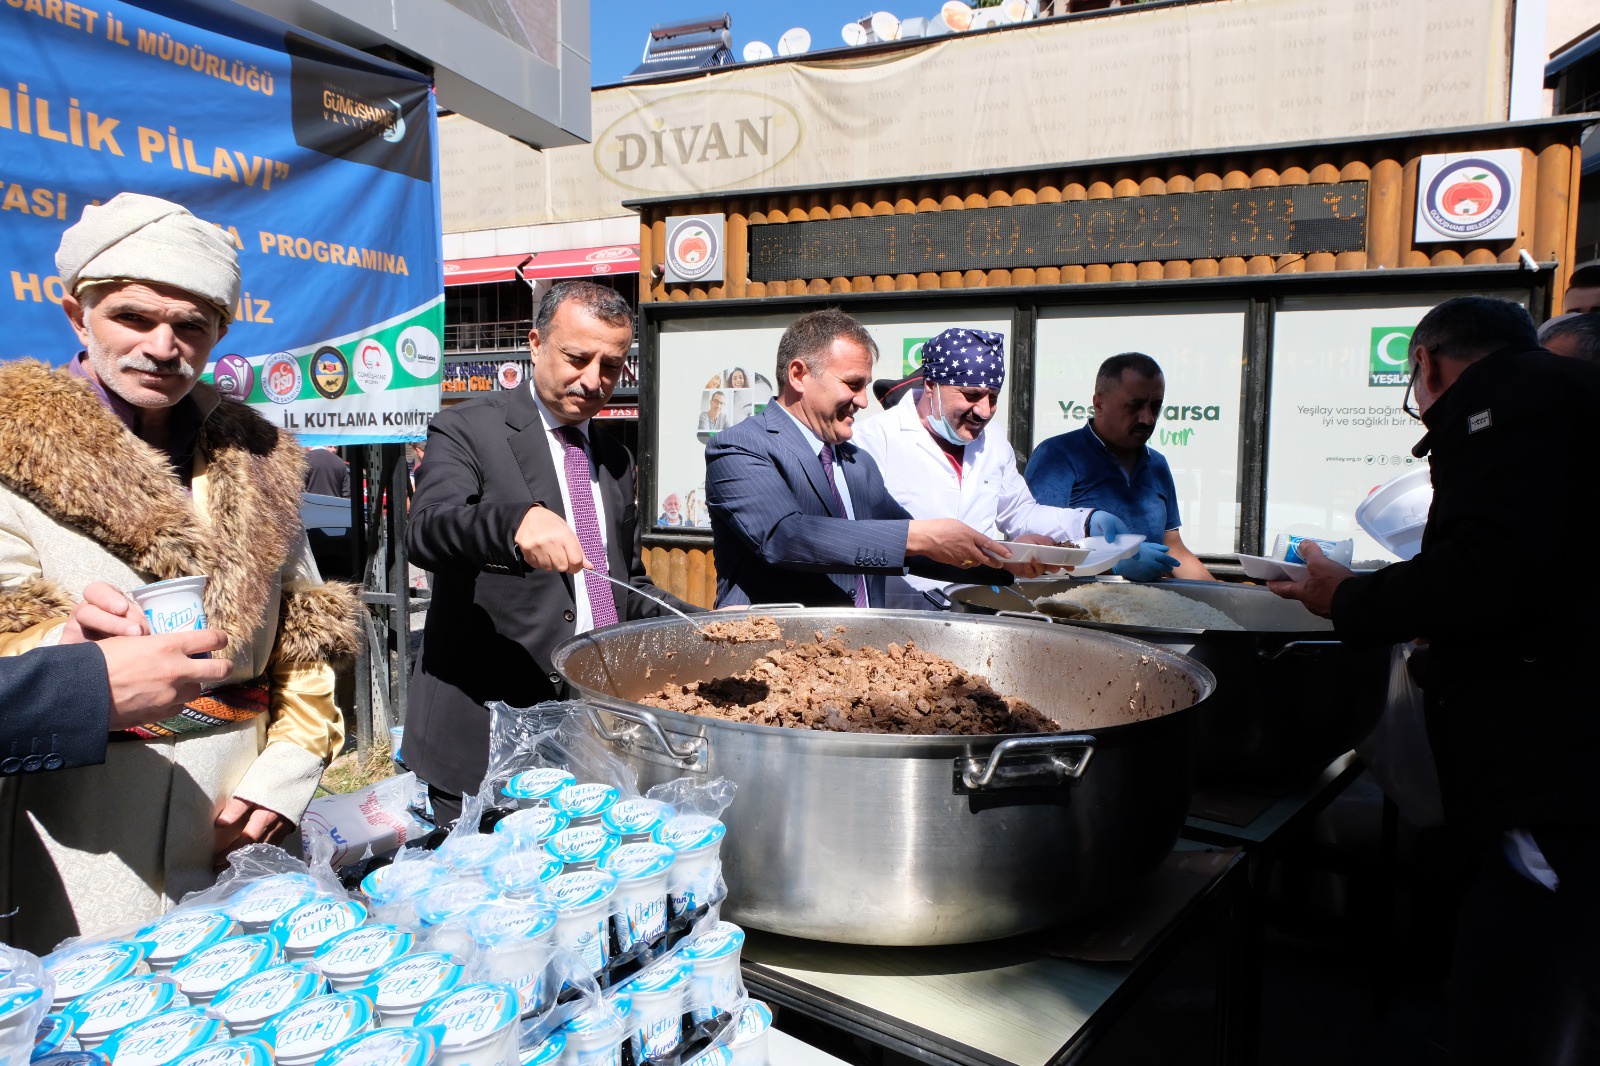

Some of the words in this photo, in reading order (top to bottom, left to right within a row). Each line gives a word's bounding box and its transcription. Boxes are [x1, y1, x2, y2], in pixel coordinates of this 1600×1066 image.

[106, 11, 130, 46] İL
[137, 27, 274, 96] MÜDÜRLÜĞÜ
[615, 115, 772, 172] DİVAN
[0, 180, 67, 220] ASI
[259, 231, 409, 276] PROGRAMINA
[284, 409, 299, 428] İL
[304, 412, 378, 427] KUTLAMA
[1297, 405, 1333, 417] Yeşilay
[1336, 407, 1366, 415] varsa
[1322, 417, 1334, 428] iyi
[1336, 418, 1349, 426] ve
[1352, 416, 1389, 428] sağlıklı
[1392, 417, 1406, 426] bir
